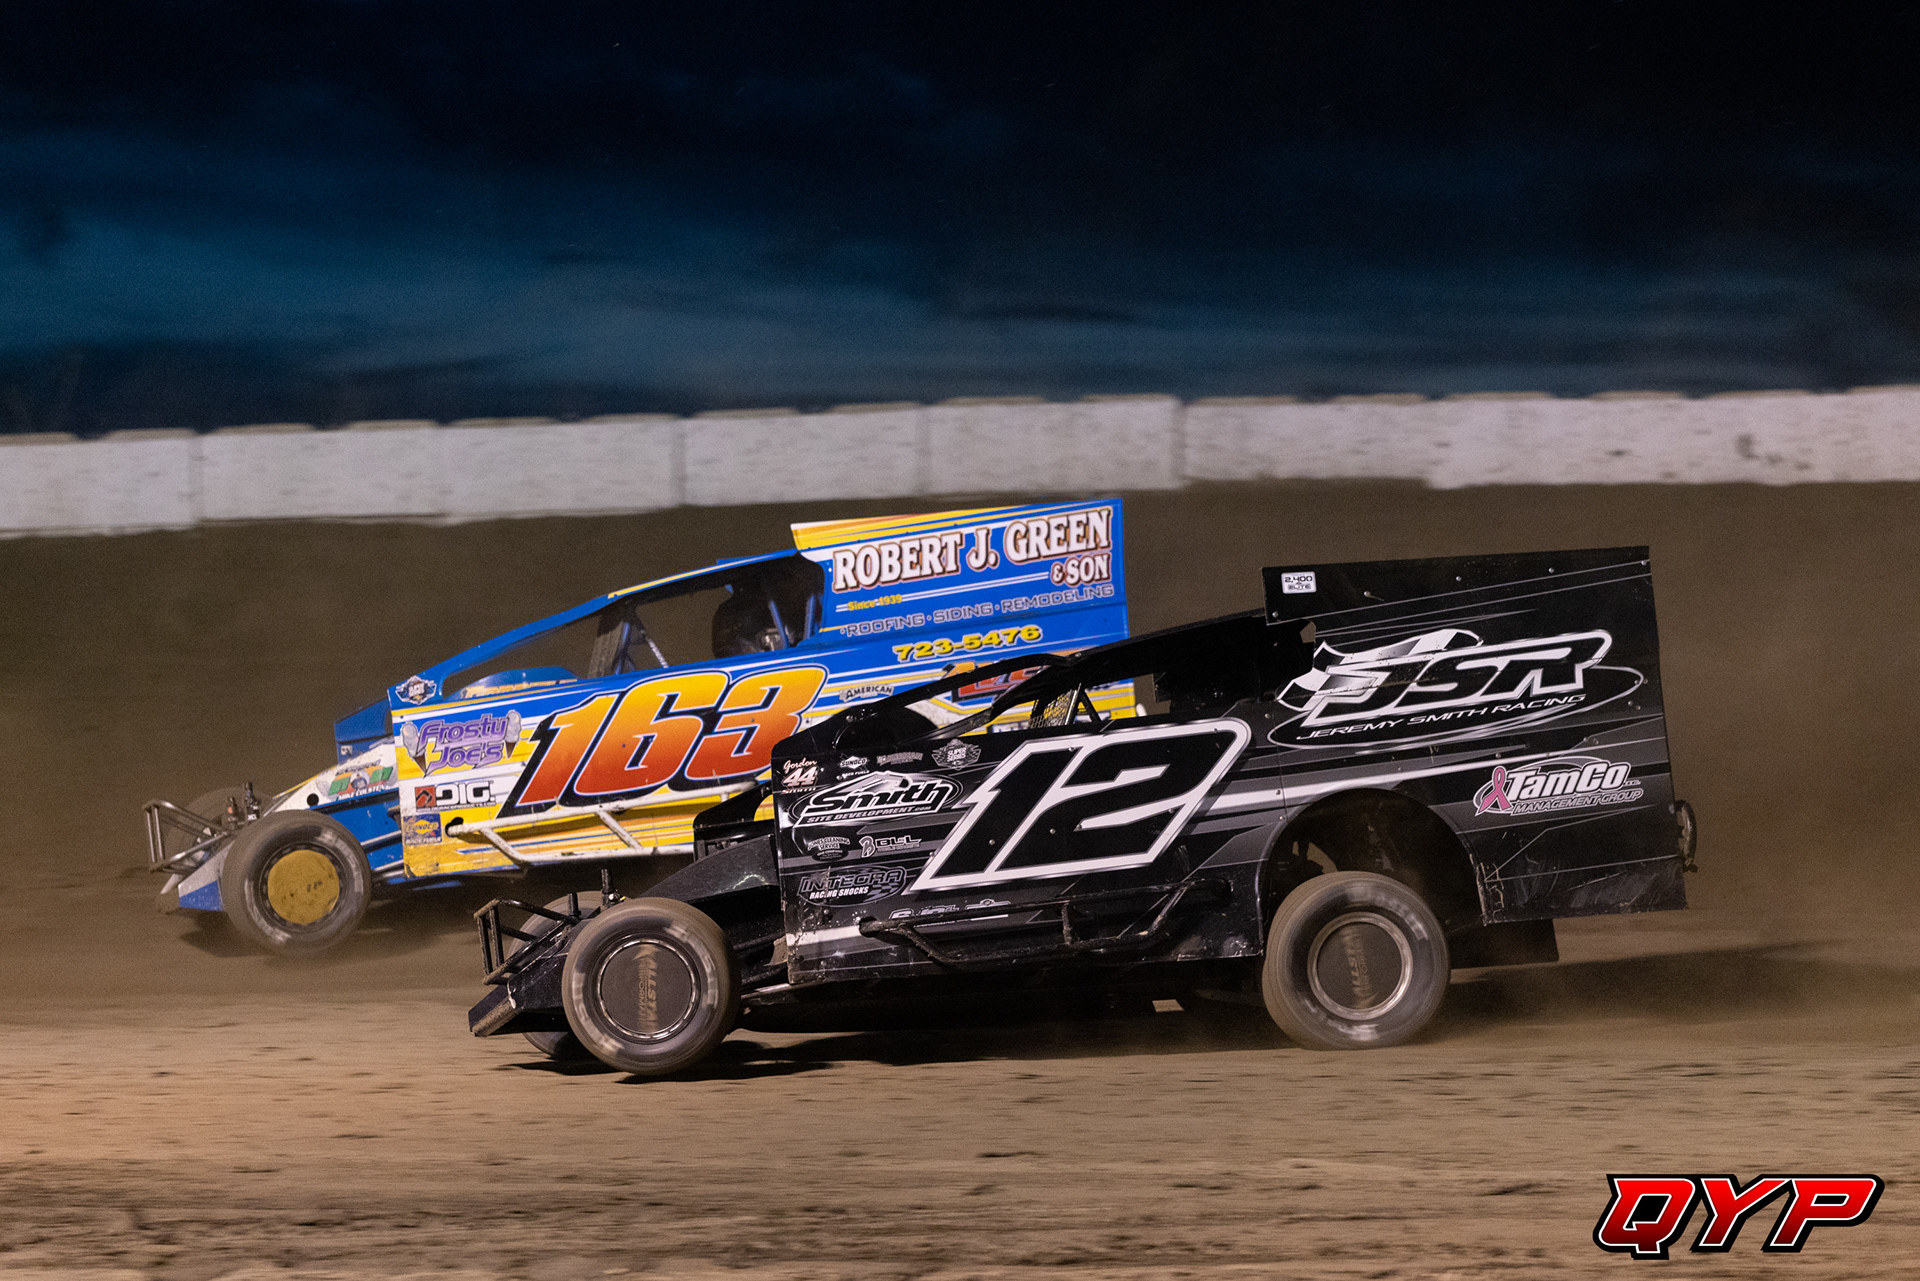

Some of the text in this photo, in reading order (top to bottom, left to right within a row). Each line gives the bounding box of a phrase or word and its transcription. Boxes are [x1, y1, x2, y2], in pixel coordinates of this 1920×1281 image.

[833, 507, 1112, 592] ROBERT J. GREEN
[1285, 575, 1313, 583] 2,400
[847, 585, 1115, 637] ROOFING SIDING REMODELING
[848, 594, 902, 611] Since 1939
[893, 625, 1042, 661] 723-5476
[846, 685, 893, 699] AMERICAN
[1301, 628, 1612, 727] JSR
[419, 714, 509, 749] Frosty
[1297, 694, 1586, 739] JEREMY SMITH RACING
[512, 664, 828, 810] 163
[783, 757, 817, 774] Gordon
[783, 767, 817, 787] 44
[840, 758, 868, 767] SUNOCO
[1506, 761, 1631, 801] TamCo
[802, 779, 953, 815] Smith
[900, 718, 1251, 894] 12
[1514, 790, 1642, 814] MANAGEMENT GROUP
[807, 815, 833, 823] SITE
[799, 868, 904, 893] INTEGRA
[838, 886, 869, 897] SHOCKS
